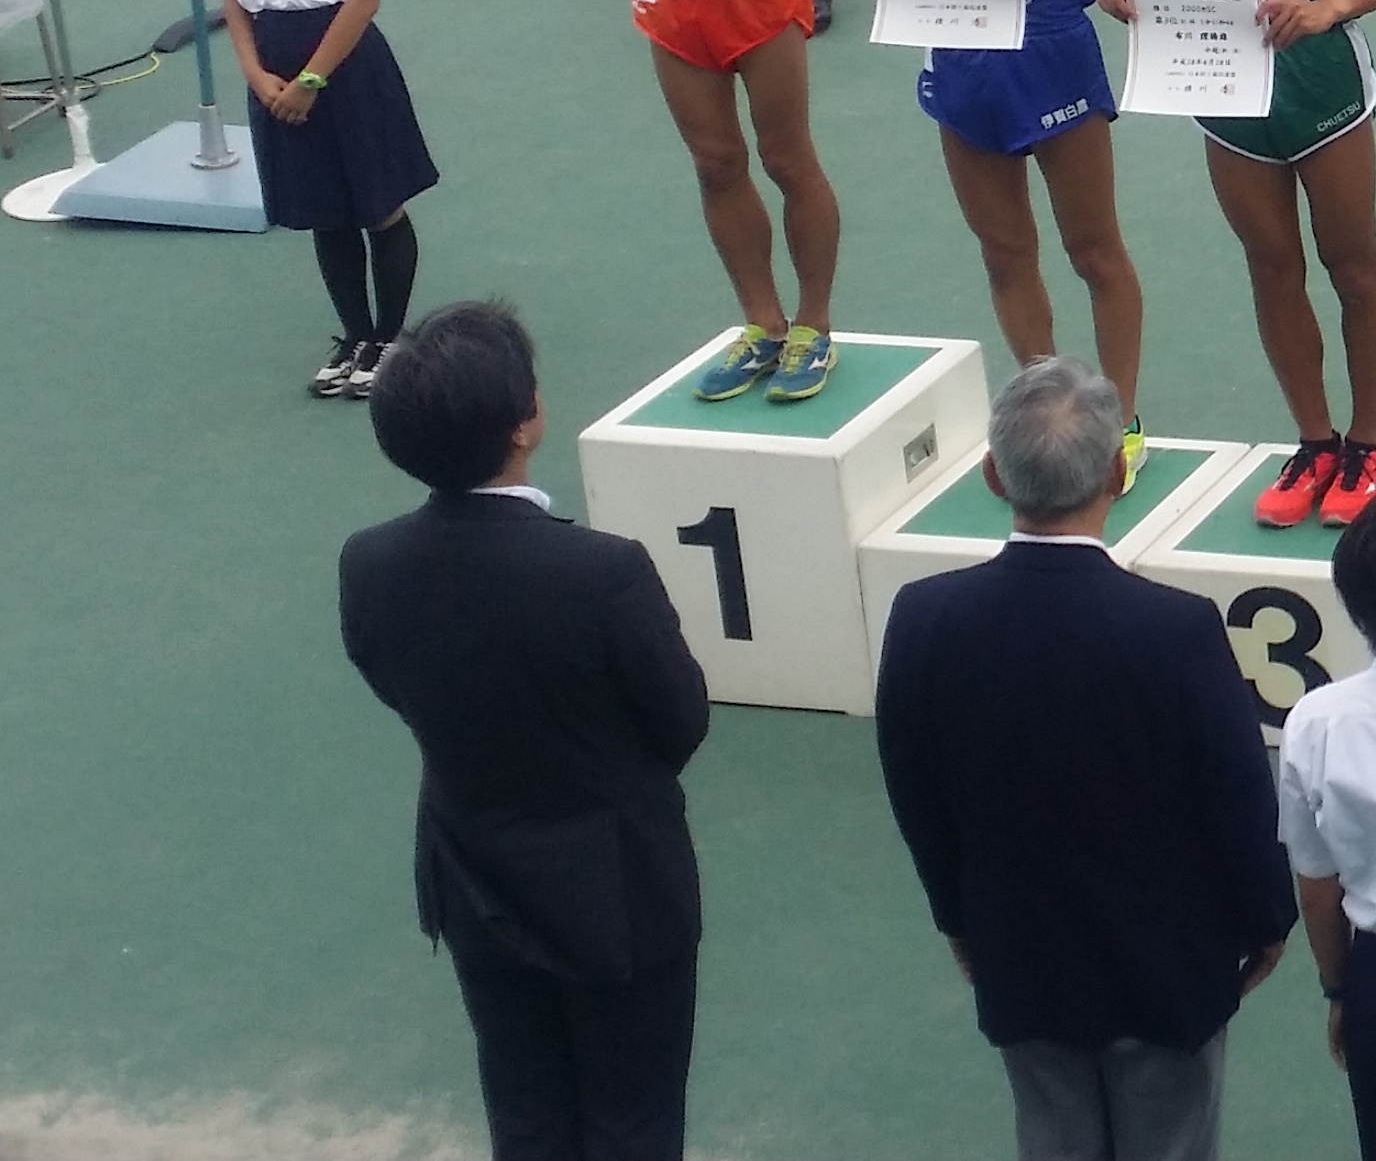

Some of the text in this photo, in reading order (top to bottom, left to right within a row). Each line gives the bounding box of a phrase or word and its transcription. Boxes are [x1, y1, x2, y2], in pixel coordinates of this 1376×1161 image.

[1316, 101, 1361, 132] CHUETSU
[676, 507, 753, 642] 1
[1227, 586, 1334, 729] 3
